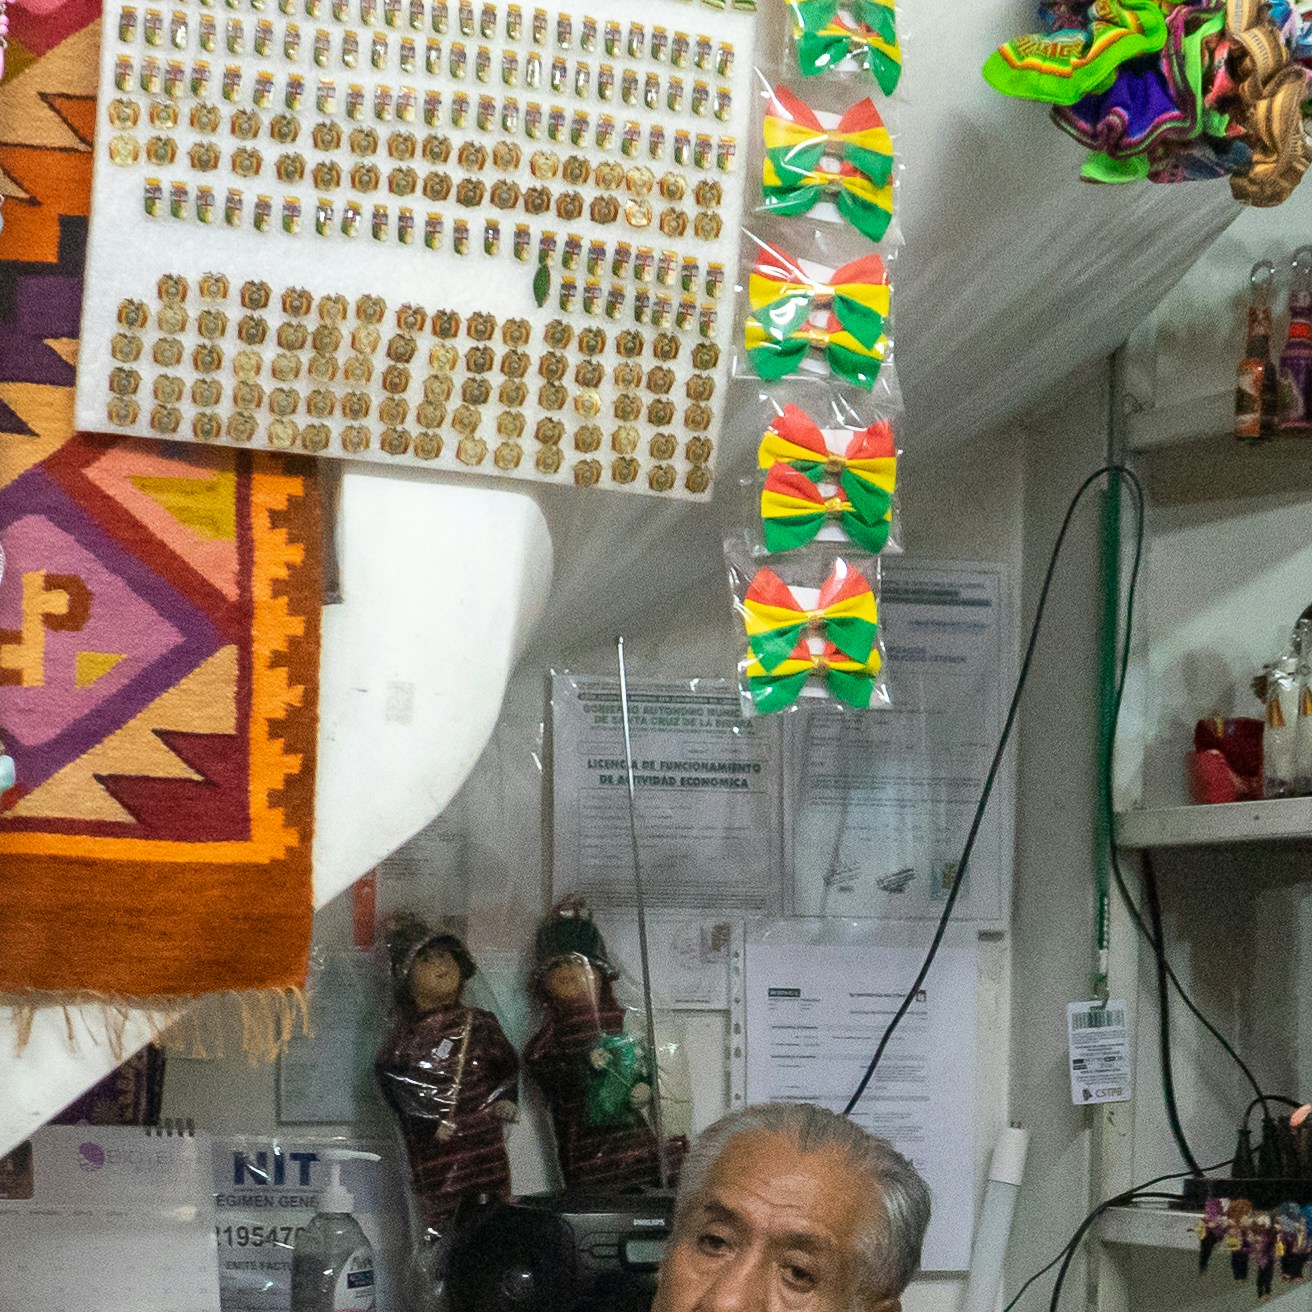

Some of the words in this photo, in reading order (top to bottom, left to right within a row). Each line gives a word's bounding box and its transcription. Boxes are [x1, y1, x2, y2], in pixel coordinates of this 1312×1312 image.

[651, 717, 680, 727] CRUZ
[587, 758, 639, 770] LICENCA
[641, 760, 656, 770] DE
[659, 760, 762, 774] FUNCIONAMIENTO
[599, 774, 614, 785] DE
[680, 776, 749, 789] ECONOMICA
[232, 1151, 320, 1186] NIT
[216, 1194, 274, 1207] EGIMEN
[279, 1195, 320, 1208] GENE
[260, 1261, 293, 1271] FACT
